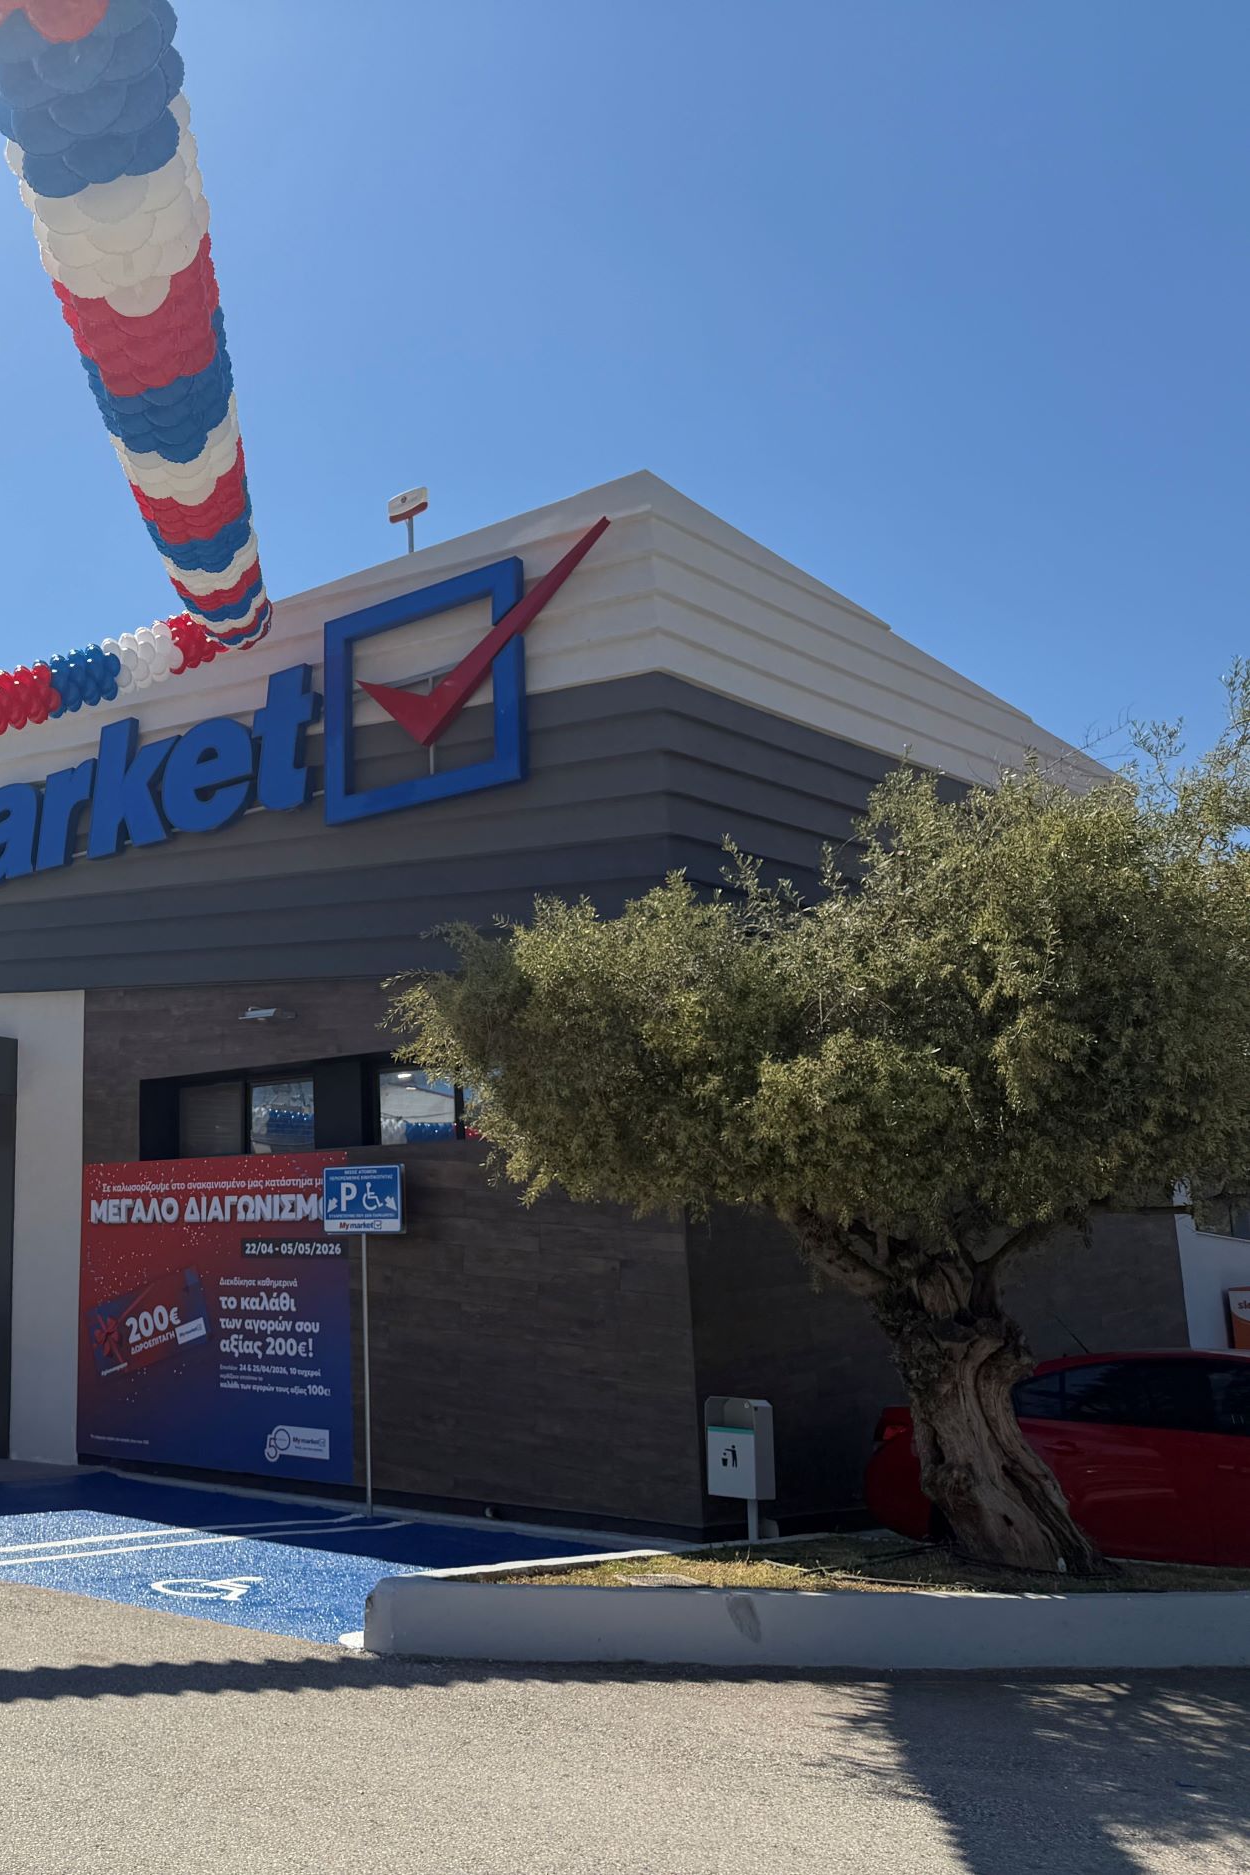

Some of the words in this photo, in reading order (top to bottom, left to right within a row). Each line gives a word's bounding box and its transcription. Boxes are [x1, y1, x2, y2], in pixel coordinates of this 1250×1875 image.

[102, 1184, 111, 1193] Σε
[171, 1182, 185, 1190] στο
[187, 1178, 245, 1191] ανακαινισμένο
[248, 1180, 263, 1190] μας
[265, 1177, 313, 1189] κατάστημα
[340, 1182, 357, 1212] P
[90, 1196, 179, 1224] ΜΕΓΑΛΟ
[245, 1241, 274, 1256] 22/04
[280, 1241, 342, 1256] 05/05/2026
[219, 1277, 256, 1288] Διεκδίκησε
[257, 1277, 298, 1289] καθημερινά
[219, 1296, 237, 1310] το
[240, 1291, 297, 1312] καλάθι
[126, 1305, 181, 1344] 200€
[219, 1318, 243, 1330] των
[244, 1315, 293, 1334] αγορών
[295, 1321, 320, 1334] σου
[131, 1330, 176, 1355] ΔΩΡΟΕΠΙΤΑΓΗ
[219, 1334, 262, 1359] αξίας
[265, 1336, 314, 1358] 200€!
[289, 1366, 297, 1375] 10
